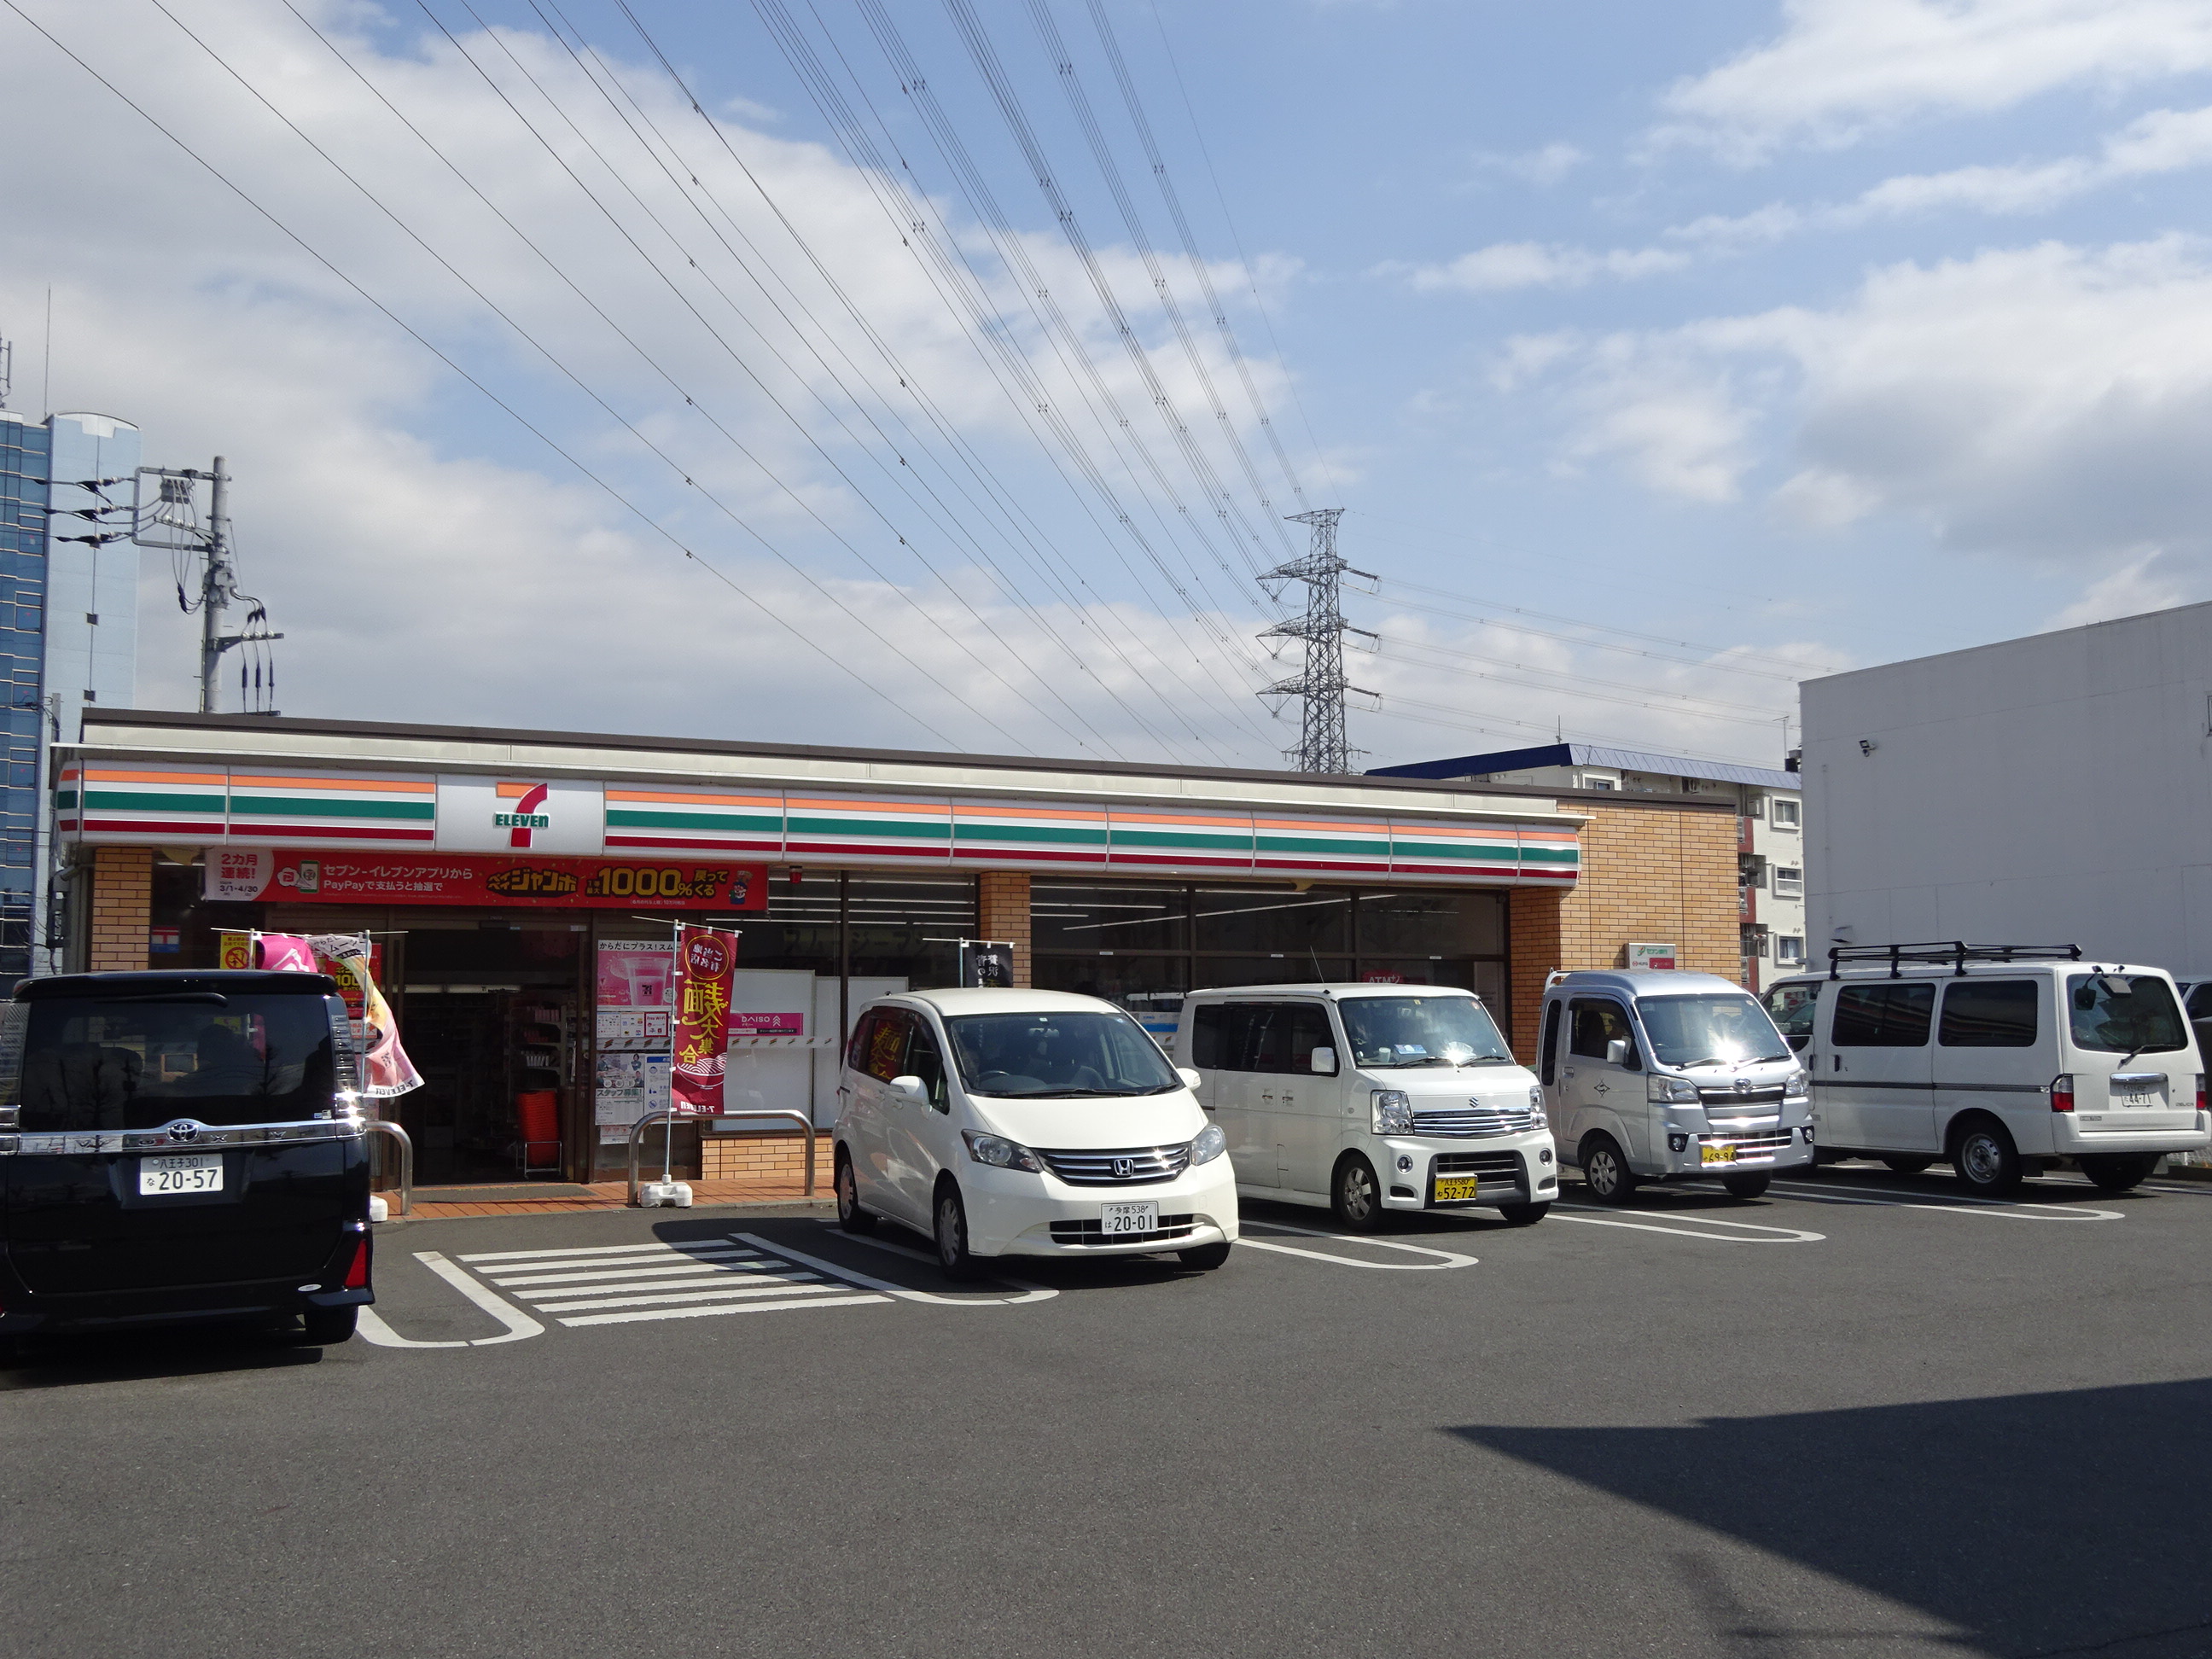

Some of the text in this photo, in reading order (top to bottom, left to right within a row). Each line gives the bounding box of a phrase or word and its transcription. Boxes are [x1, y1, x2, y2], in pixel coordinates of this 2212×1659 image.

[497, 782, 548, 847] 7
[221, 853, 258, 865] 2カ月
[2129, 1093, 2151, 1103] 44-71
[159, 1168, 218, 1190] 20-57
[1444, 1186, 1475, 1200] 52-72
[1114, 1214, 1153, 1231] 20-01
